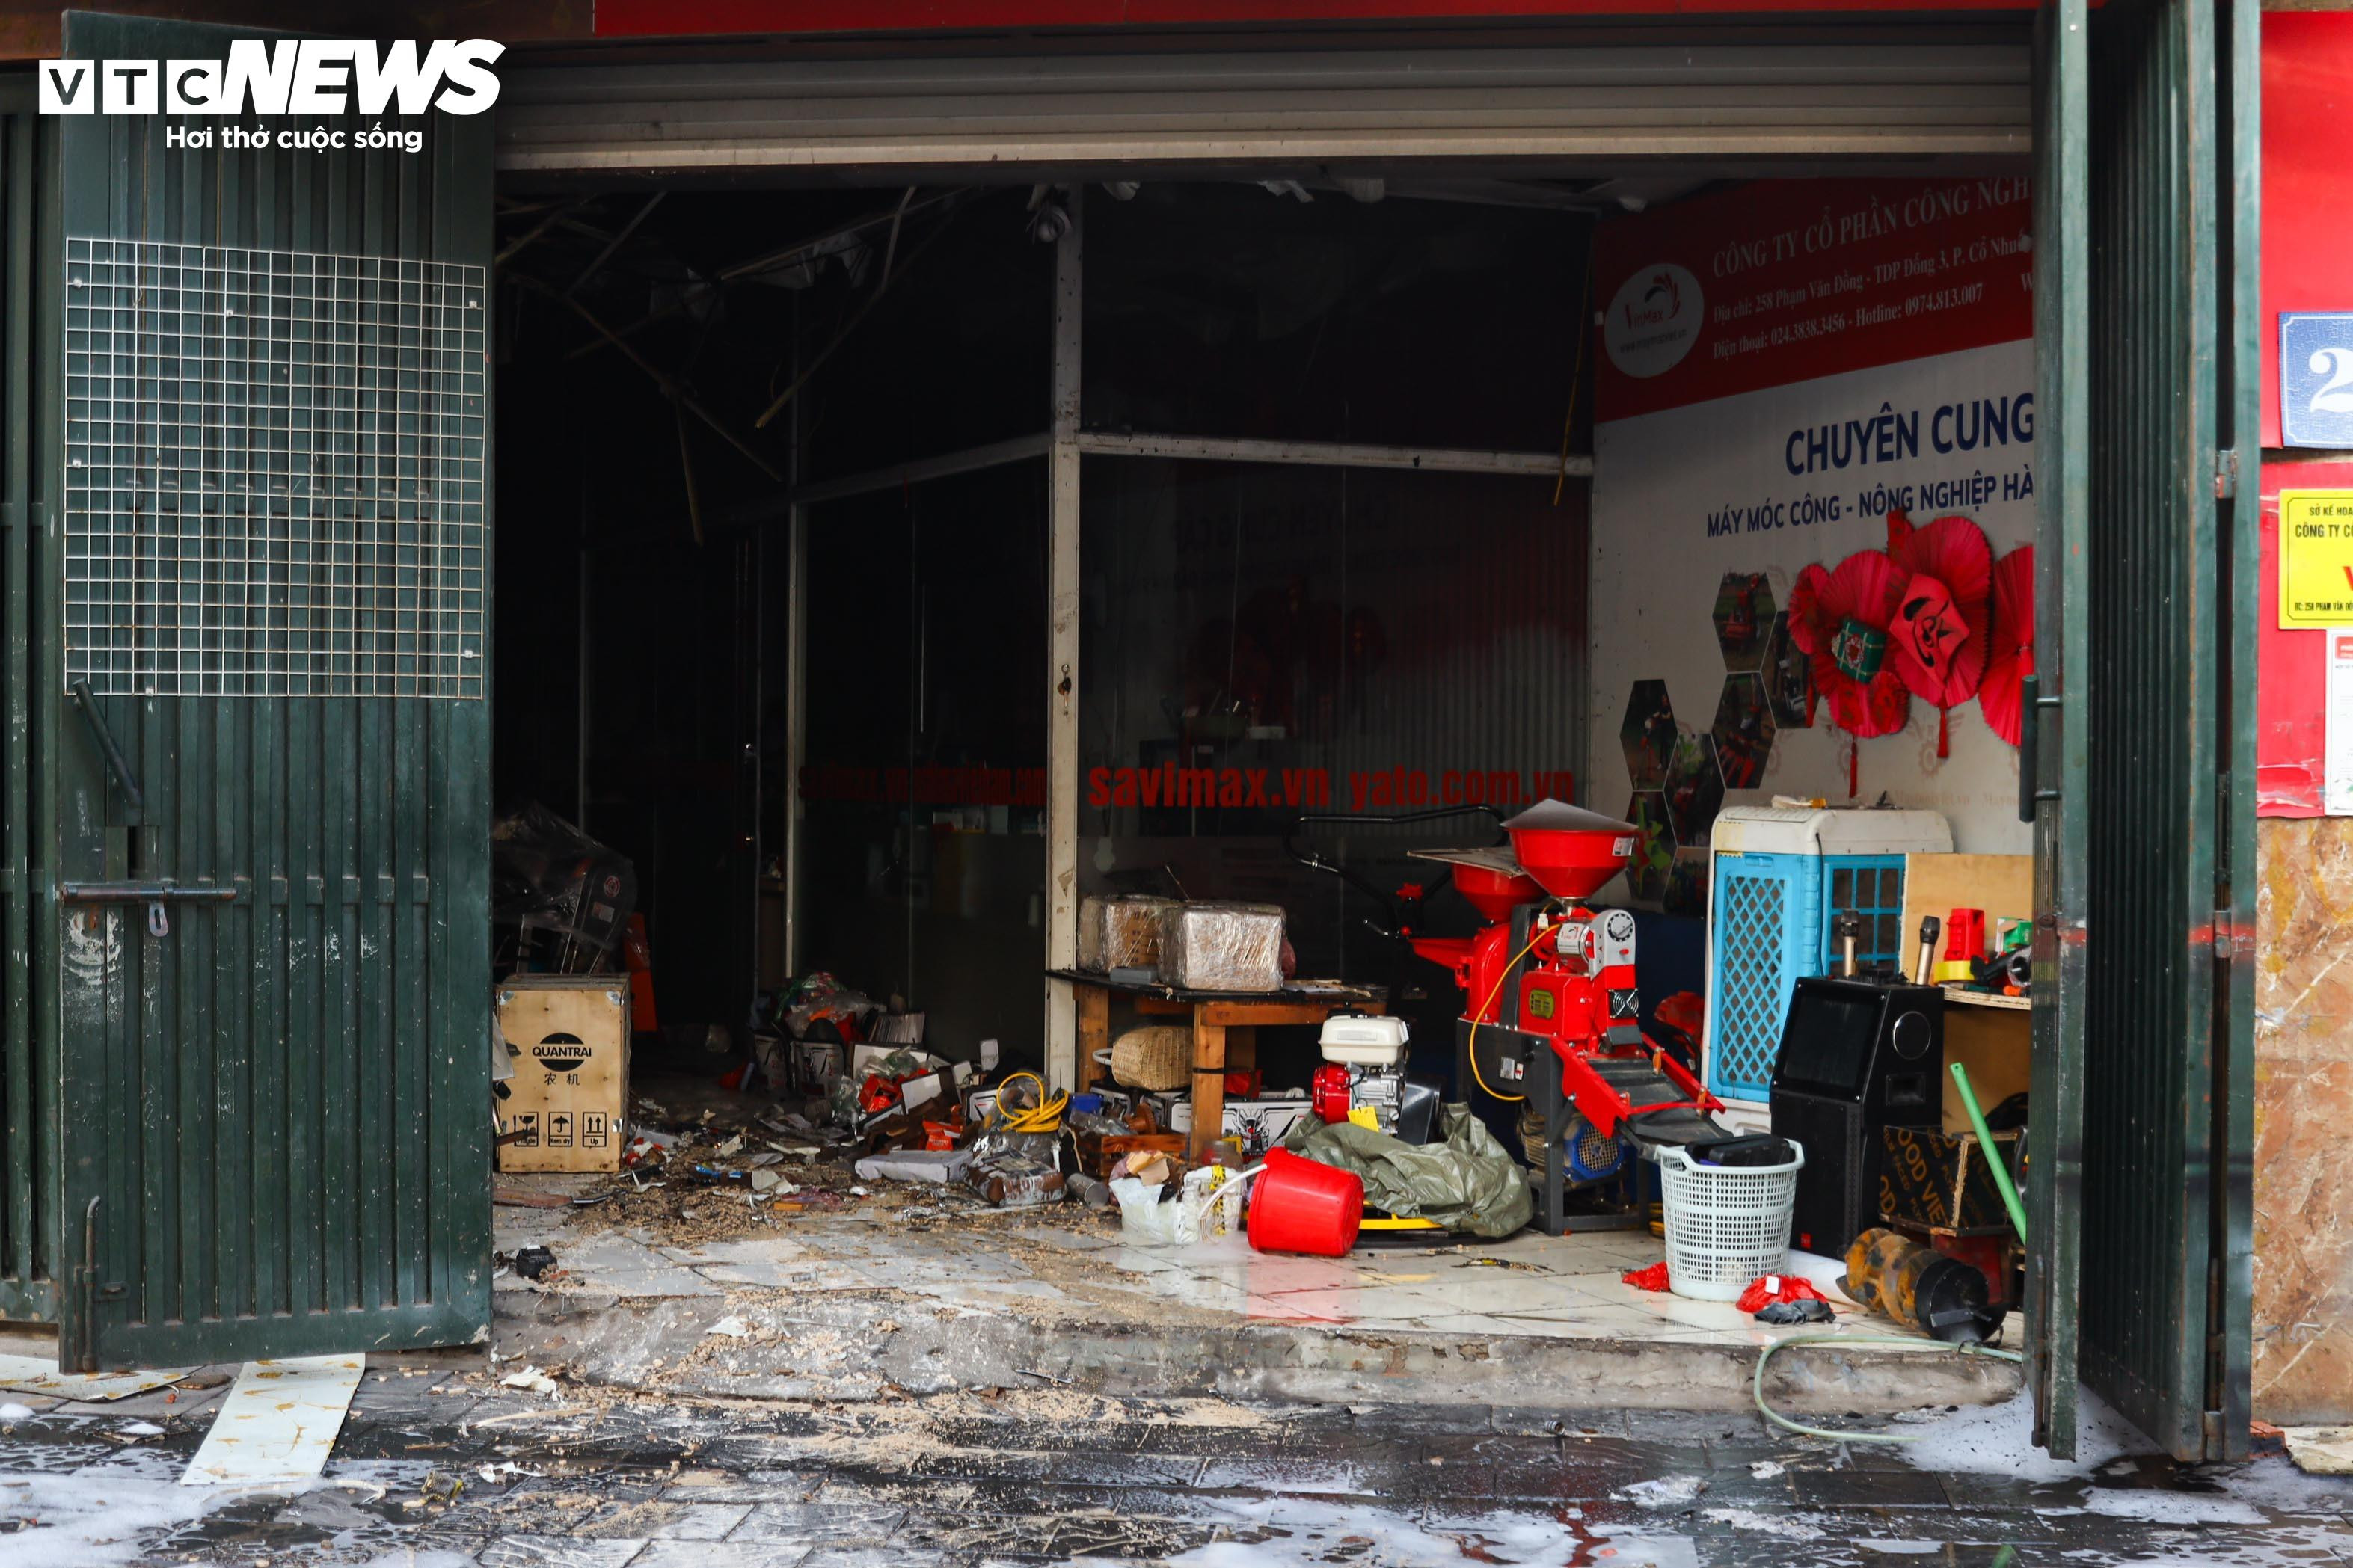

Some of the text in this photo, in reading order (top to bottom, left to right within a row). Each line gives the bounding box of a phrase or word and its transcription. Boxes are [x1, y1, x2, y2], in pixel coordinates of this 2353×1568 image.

[1713, 240, 1767, 279] CÔNG
[1772, 230, 1799, 262] TY
[1839, 194, 1898, 246] PHẦN
[1904, 185, 1969, 228] CÔNG
[1776, 288, 1806, 310] Phạm
[1874, 261, 1901, 284] TDP
[1856, 307, 1903, 329] Hotline:
[1905, 282, 1984, 318] 0974.813.007
[1785, 392, 2034, 476] CHUYÊN CUNG
[1707, 504, 1744, 538] MÁY
[1747, 496, 1784, 532] MÓC
[1790, 492, 1840, 526] CÔNG
[1859, 482, 1913, 518] NÔNG
[1920, 470, 1997, 512] NGHIỆP
[2309, 502, 2321, 517] SỞ
[2323, 503, 2334, 517] KẾ
[2295, 521, 2325, 538] CÔNG
[2328, 524, 2340, 538] TY
[1088, 760, 1330, 808] savimax.vn
[1349, 764, 1575, 811] yato.com.vn
[532, 1046, 592, 1058] QUANTRAI
[590, 1137, 598, 1146] Up
